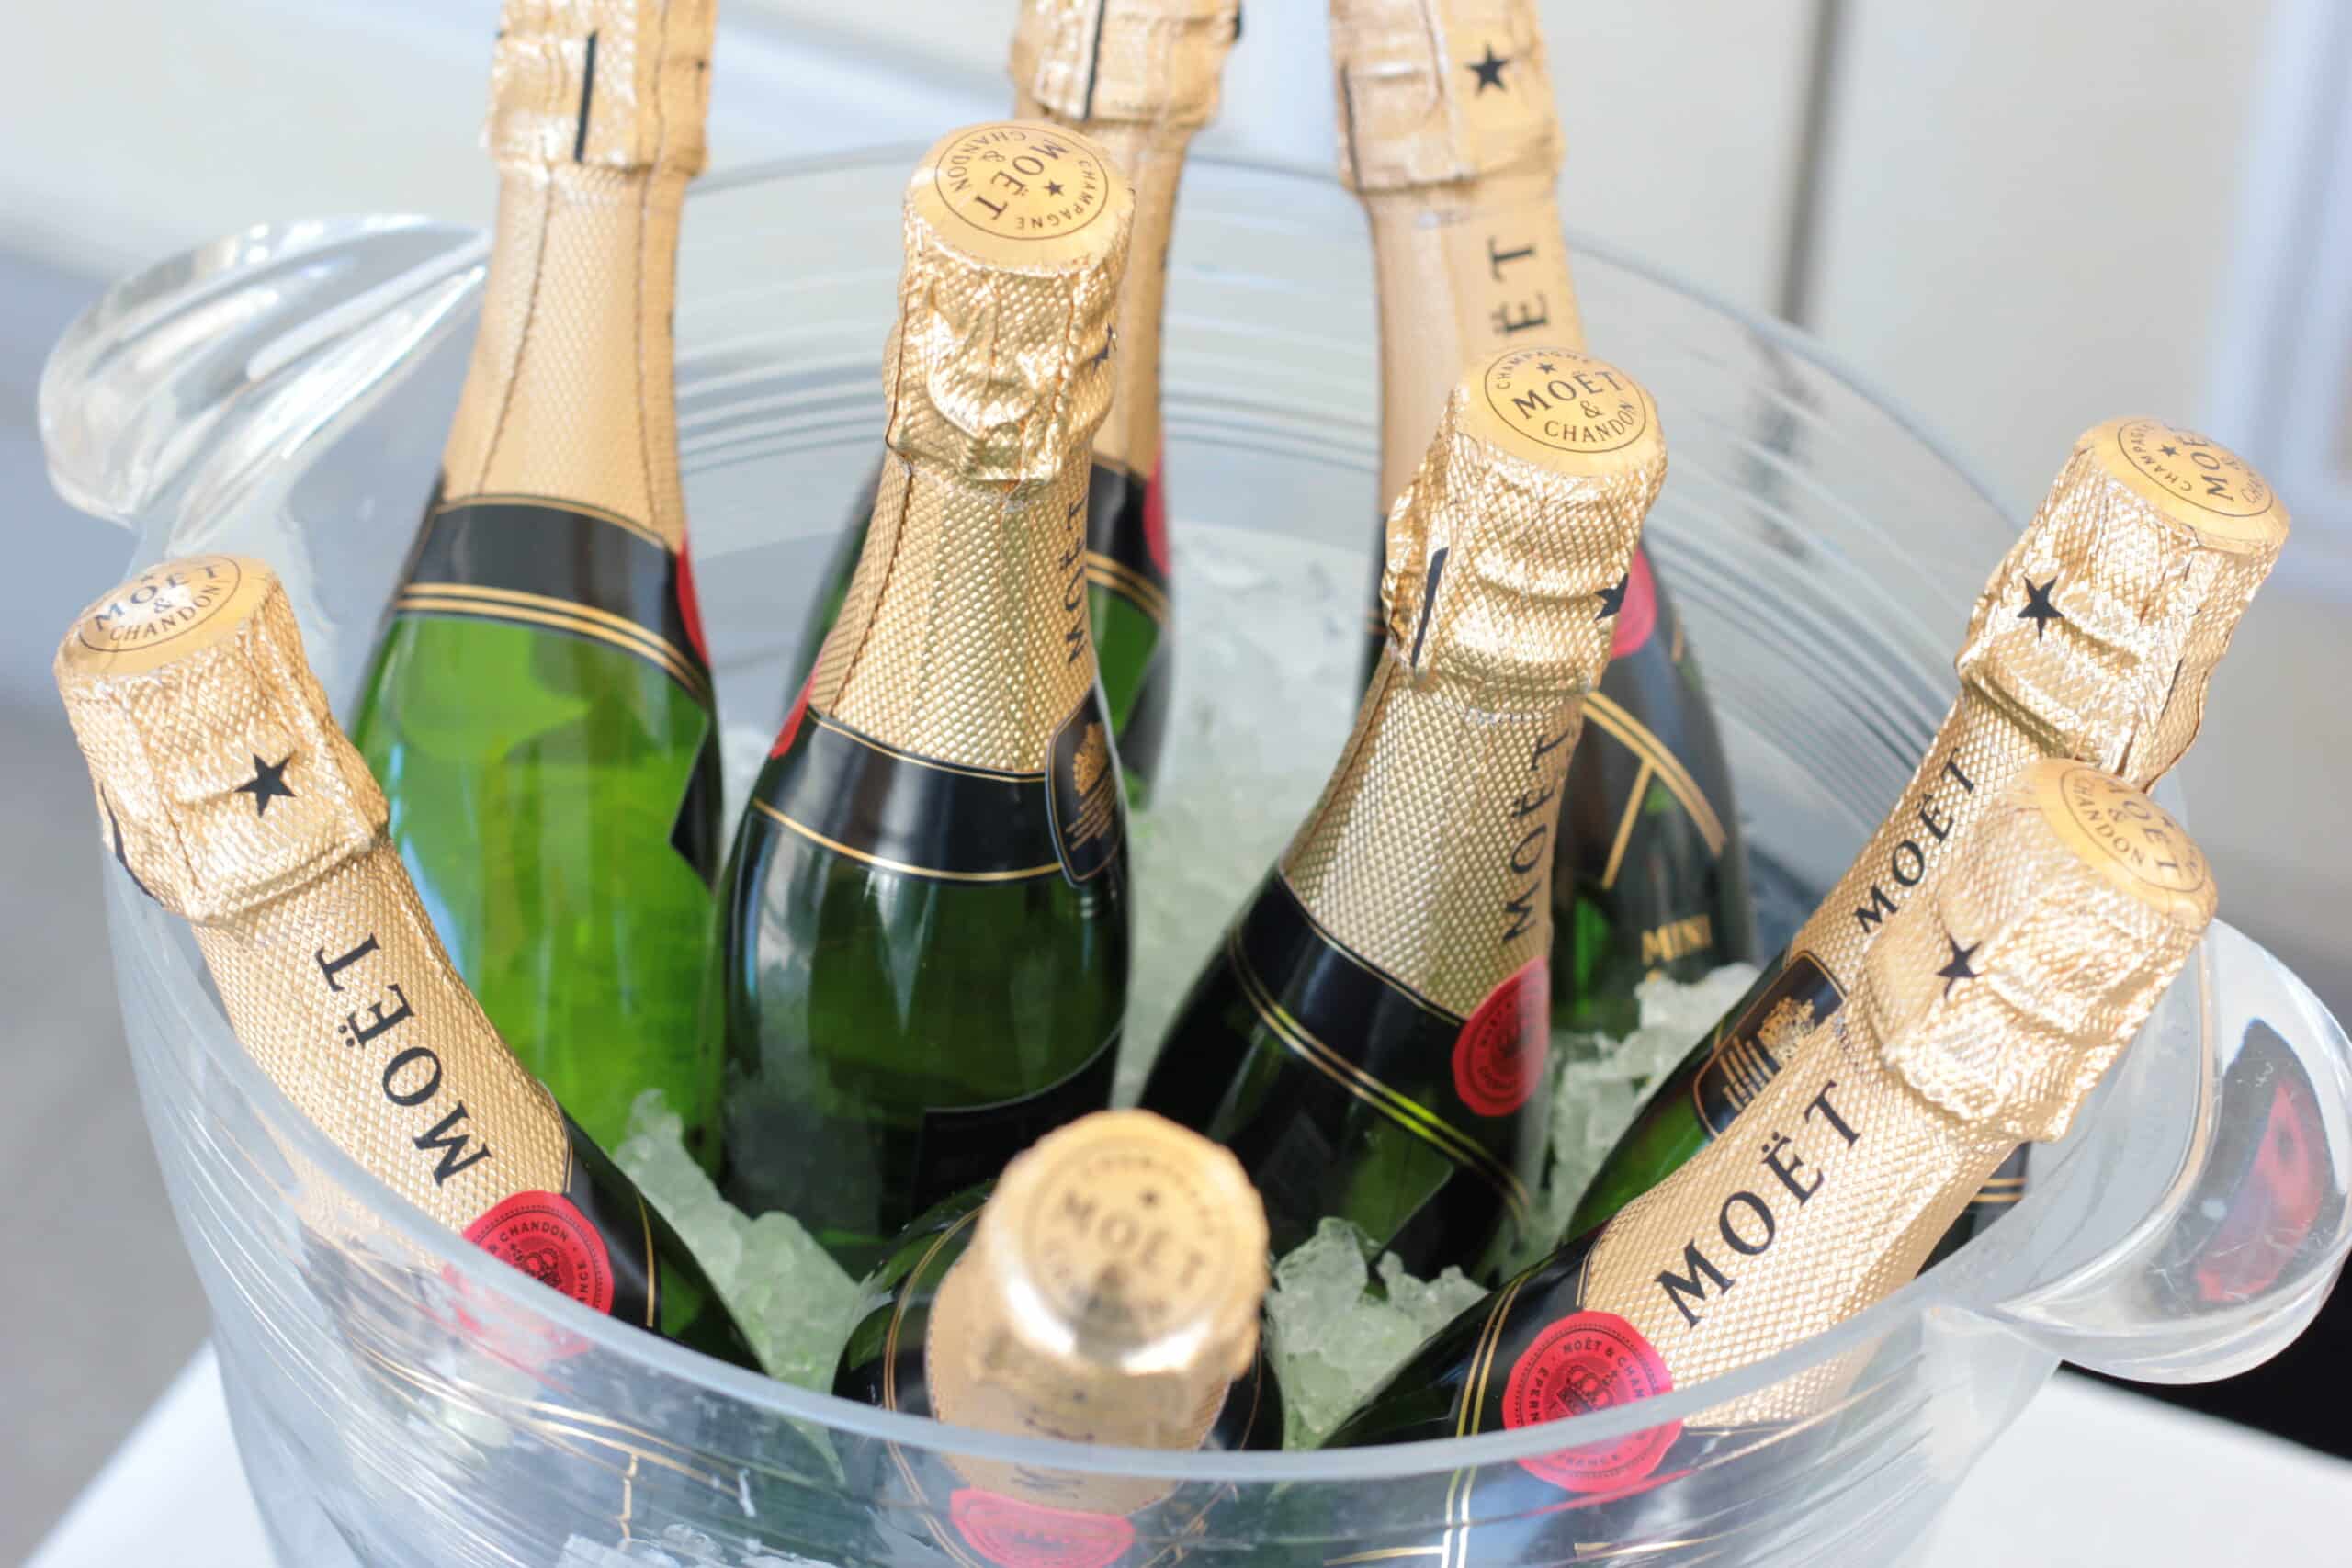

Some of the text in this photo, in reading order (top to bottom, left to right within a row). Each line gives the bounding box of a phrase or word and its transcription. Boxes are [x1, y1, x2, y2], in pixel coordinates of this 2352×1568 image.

[947, 130, 1027, 192] CHANDON
[974, 139, 1071, 221] MOËT
[1013, 158, 1098, 230] CHAMPAGNE
[1488, 235, 1551, 337] ËT
[1510, 369, 1623, 420] MOËT
[1544, 401, 1635, 443] CHANDON
[1579, 400, 1604, 419] &
[109, 584, 221, 642] CHANDON
[1503, 728, 1572, 942] MOËT
[1853, 746, 1975, 935] MOËT
[314, 932, 493, 1189] MOËT
[499, 1221, 570, 1243] CHANDON
[1653, 1079, 1861, 1329] MOËT
